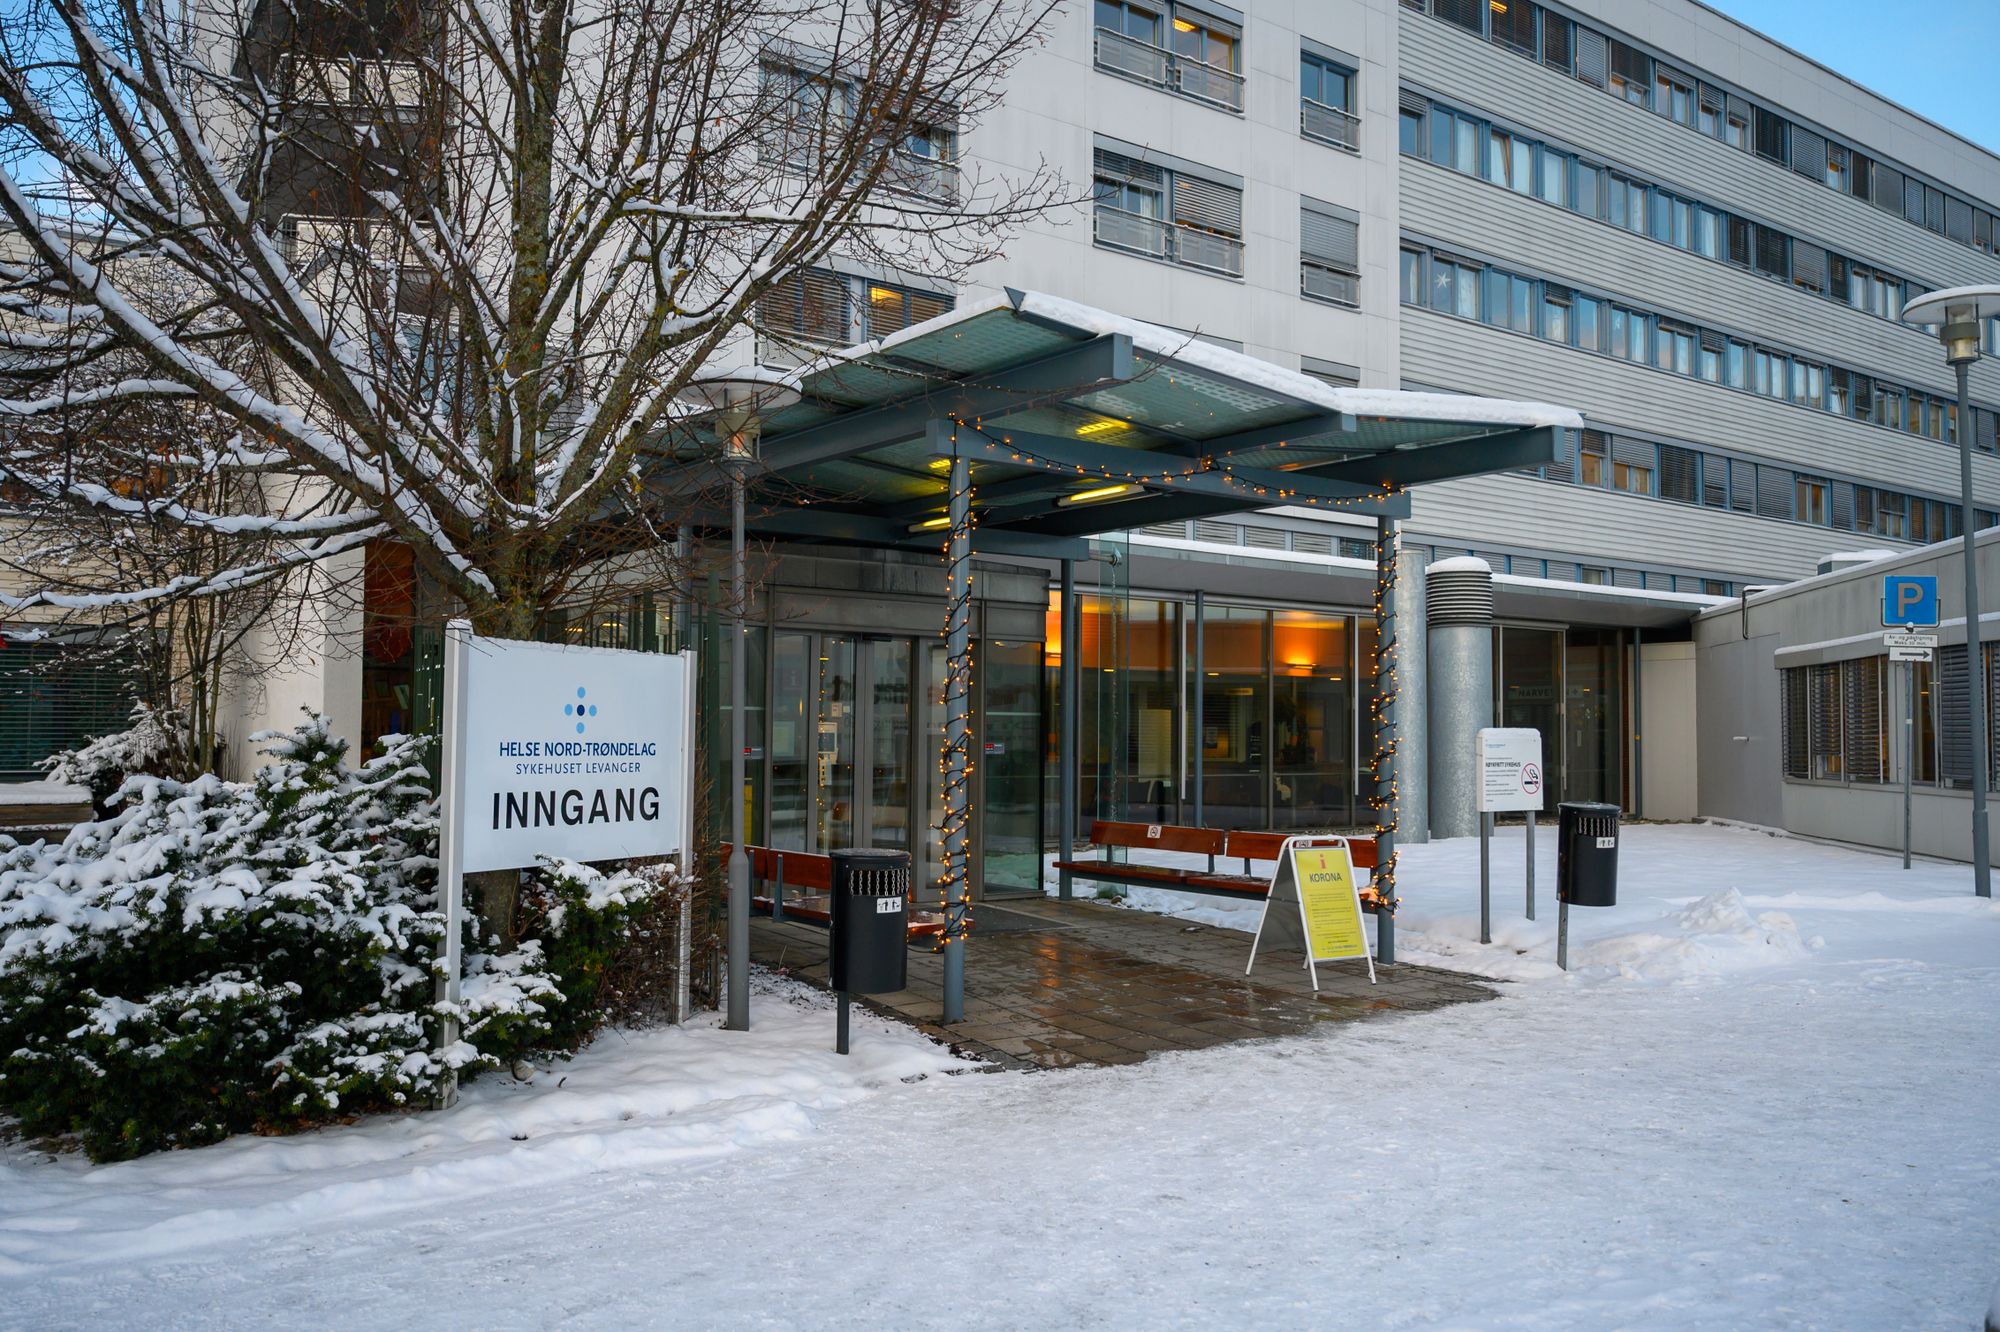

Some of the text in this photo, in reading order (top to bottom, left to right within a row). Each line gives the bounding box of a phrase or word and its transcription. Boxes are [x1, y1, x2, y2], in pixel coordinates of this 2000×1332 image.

[1898, 583, 1923, 617] P
[1518, 687, 1569, 697] NARVEN
[499, 742, 656, 756] HELSE NORD-TRØNDELAG
[516, 762, 641, 775] SYKEHUSET LEVANGER
[492, 787, 660, 830] INNGANG
[1309, 873, 1342, 883] KORONA
